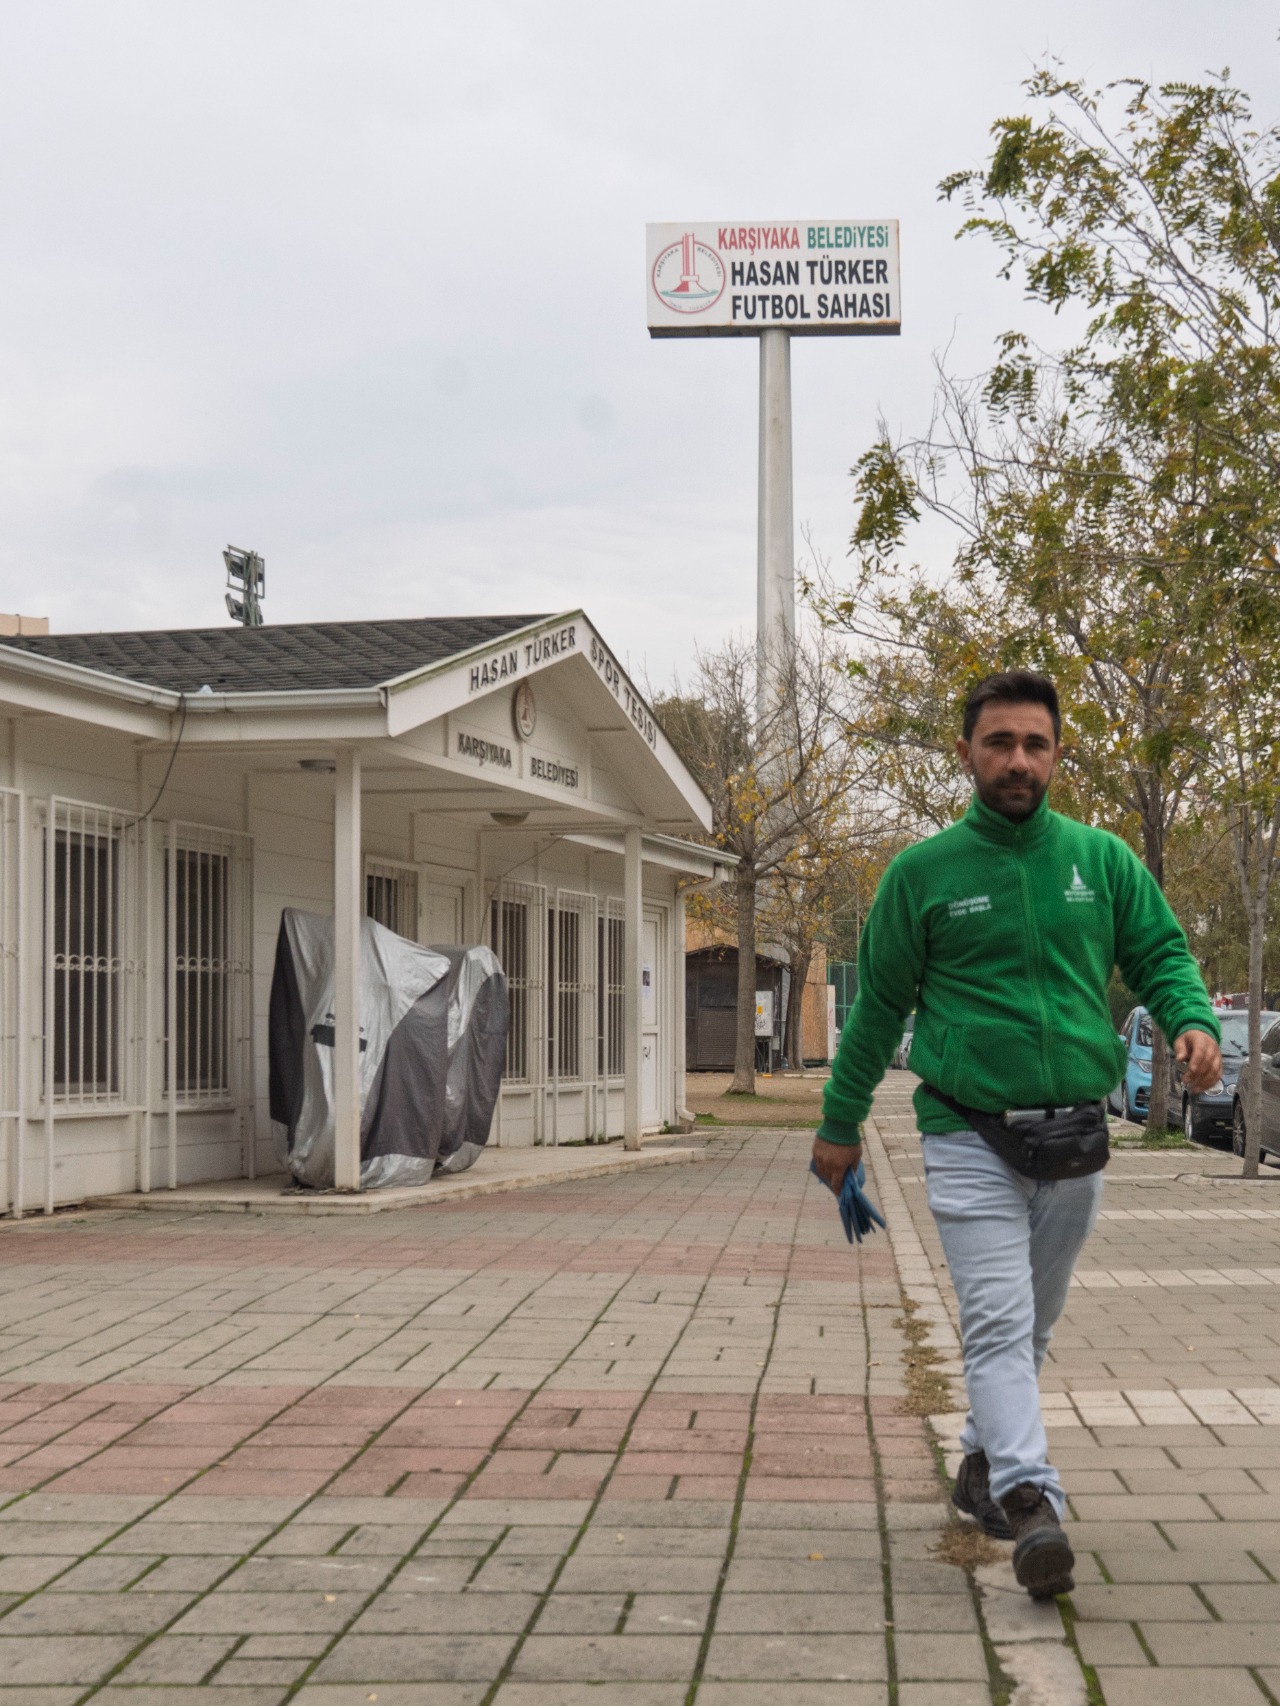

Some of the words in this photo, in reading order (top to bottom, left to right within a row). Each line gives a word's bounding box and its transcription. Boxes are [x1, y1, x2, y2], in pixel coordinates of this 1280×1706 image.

[718, 227, 800, 255] KARŞIYAKA
[731, 260, 800, 286] HASAN
[806, 254, 889, 285] TÜRKER
[732, 294, 811, 320] FUTBOL
[817, 292, 891, 319] SAHASI
[469, 650, 518, 692] HASAN
[525, 625, 576, 667] TÜRKER
[590, 636, 620, 698] SPOR
[457, 732, 512, 768] KARŞIYAKA
[530, 756, 579, 789] BELEDİYESİ
